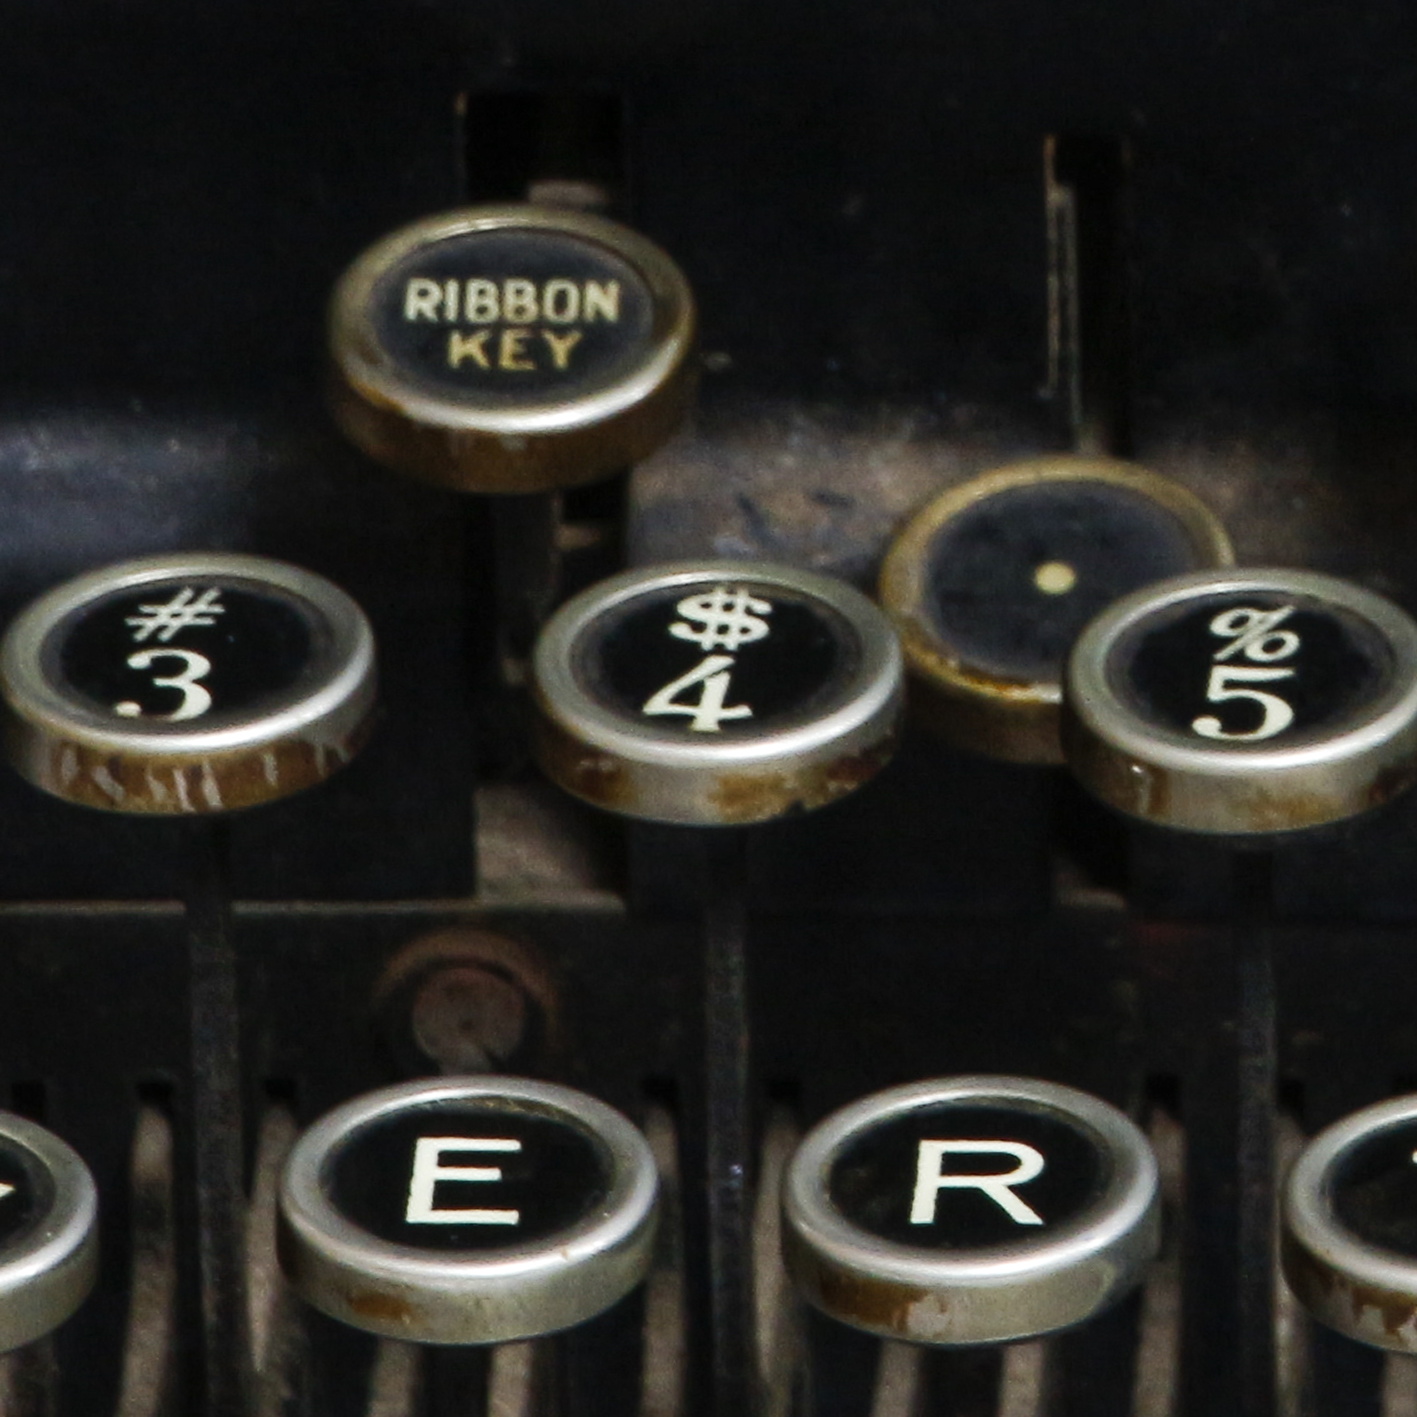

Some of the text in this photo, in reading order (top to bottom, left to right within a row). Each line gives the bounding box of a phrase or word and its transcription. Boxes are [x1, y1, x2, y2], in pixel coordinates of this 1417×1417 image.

[404, 278, 620, 324] RIBBON
[447, 329, 582, 370] KEY
[127, 588, 224, 640] #
[667, 587, 773, 652] $
[1211, 606, 1299, 661] %
[116, 650, 211, 721] 3
[643, 656, 752, 732] 4
[1192, 666, 1293, 740] 5
[406, 1138, 520, 1224] E
[910, 1140, 1044, 1224] R
